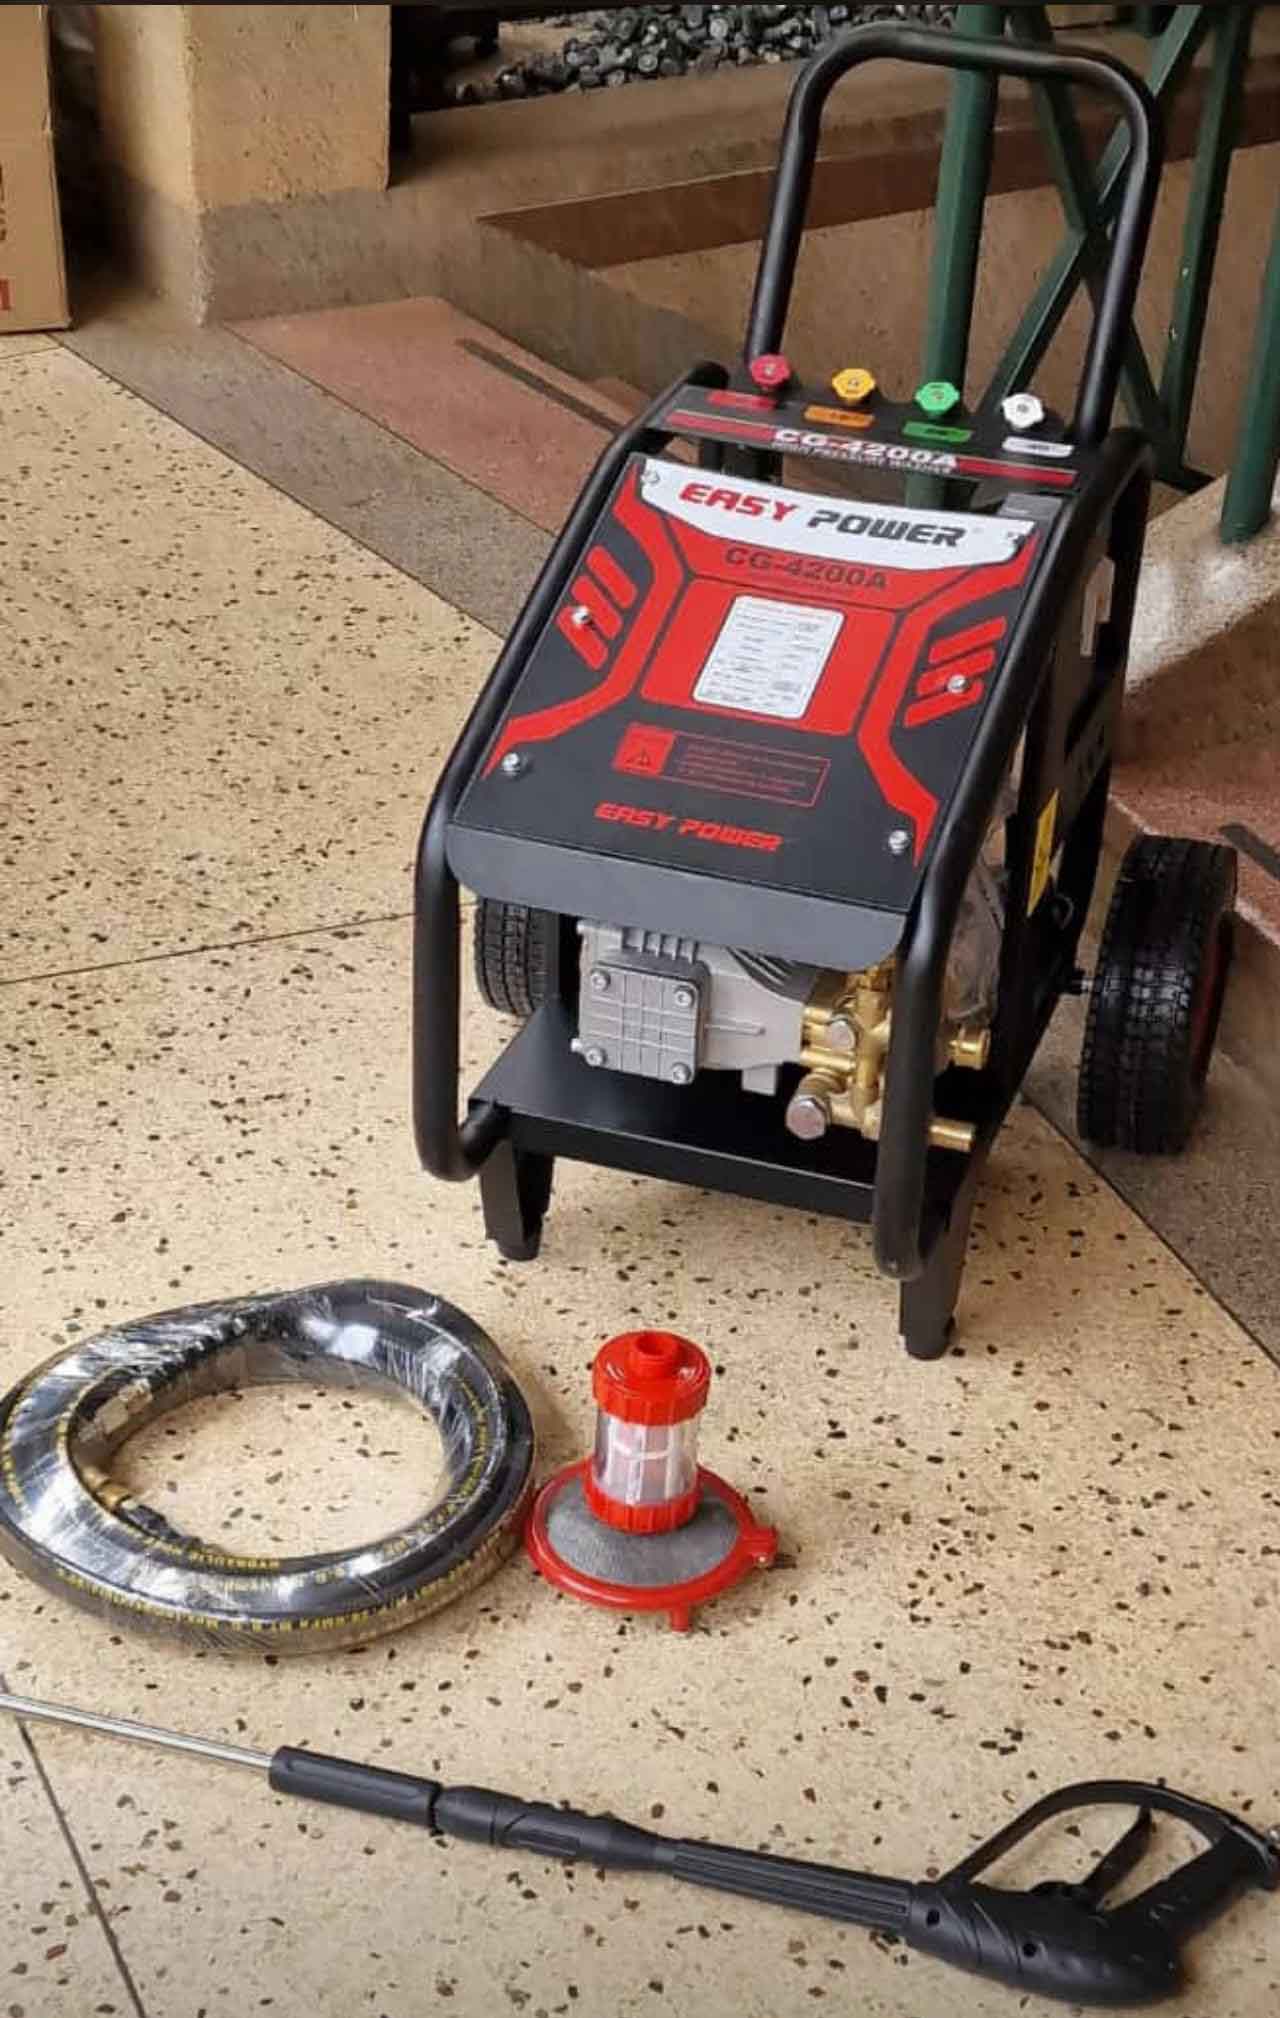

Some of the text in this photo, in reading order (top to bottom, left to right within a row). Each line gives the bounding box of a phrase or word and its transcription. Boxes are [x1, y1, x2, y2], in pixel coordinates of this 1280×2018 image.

[772, 428, 958, 468] CG-4200A
[679, 482, 967, 548] EASY POWER
[724, 546, 888, 590] CG-4200A
[594, 801, 783, 852] EASY POWER
